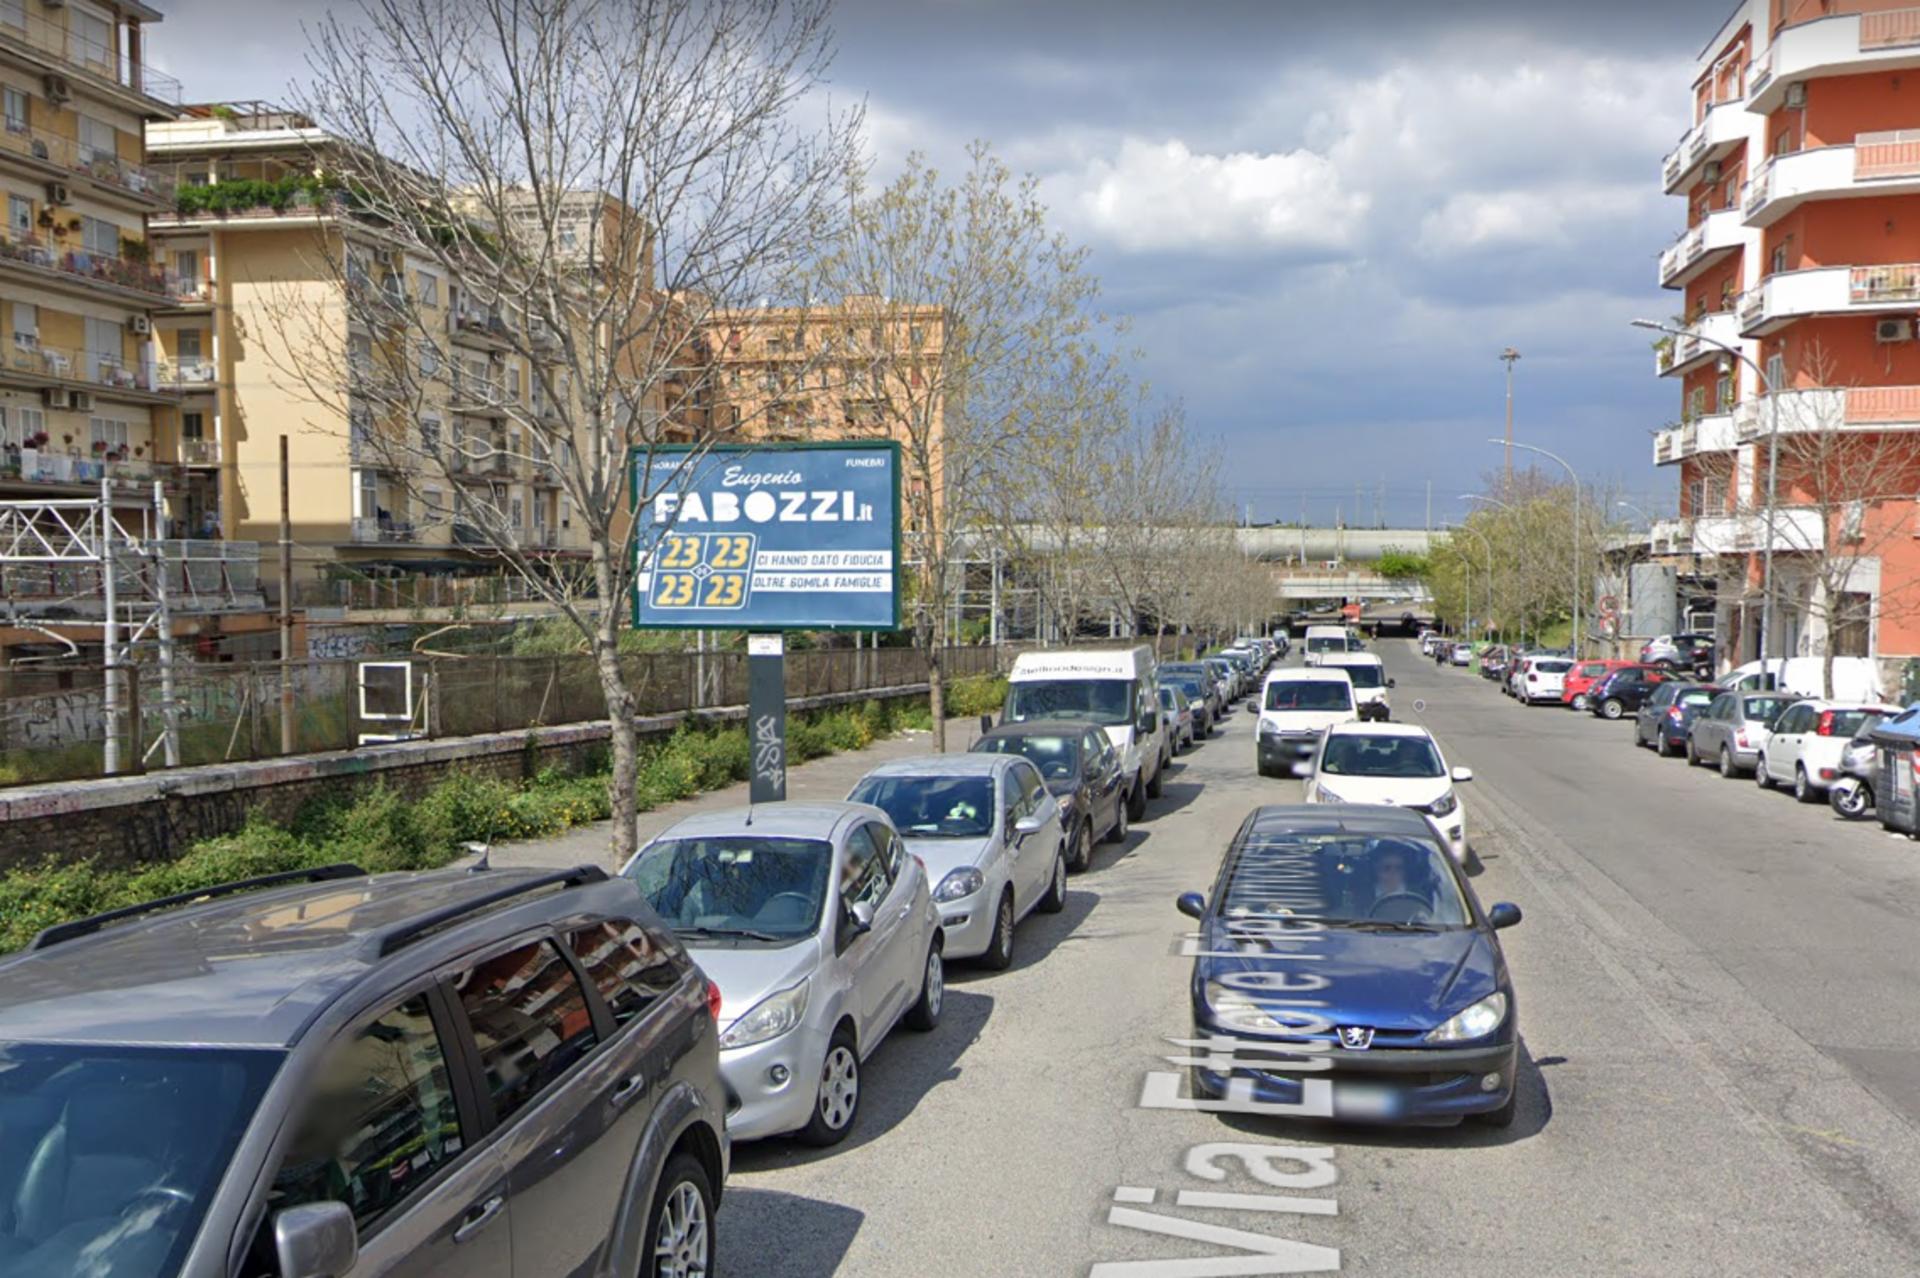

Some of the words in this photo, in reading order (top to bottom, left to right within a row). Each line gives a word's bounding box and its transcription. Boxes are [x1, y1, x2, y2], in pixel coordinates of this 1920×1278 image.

[845, 457, 885, 468] FUNEBRI
[722, 465, 802, 490] Eugenio
[661, 537, 700, 567] 23
[711, 537, 749, 567] 23
[757, 555, 768, 566] CI
[771, 555, 808, 566] HANNO
[811, 555, 839, 566] DATO
[843, 555, 883, 566] FIDUCIA
[656, 575, 694, 605] 23
[705, 575, 742, 605] 23
[753, 577, 785, 588] OLTRE
[834, 577, 882, 588] FAMIGLIE
